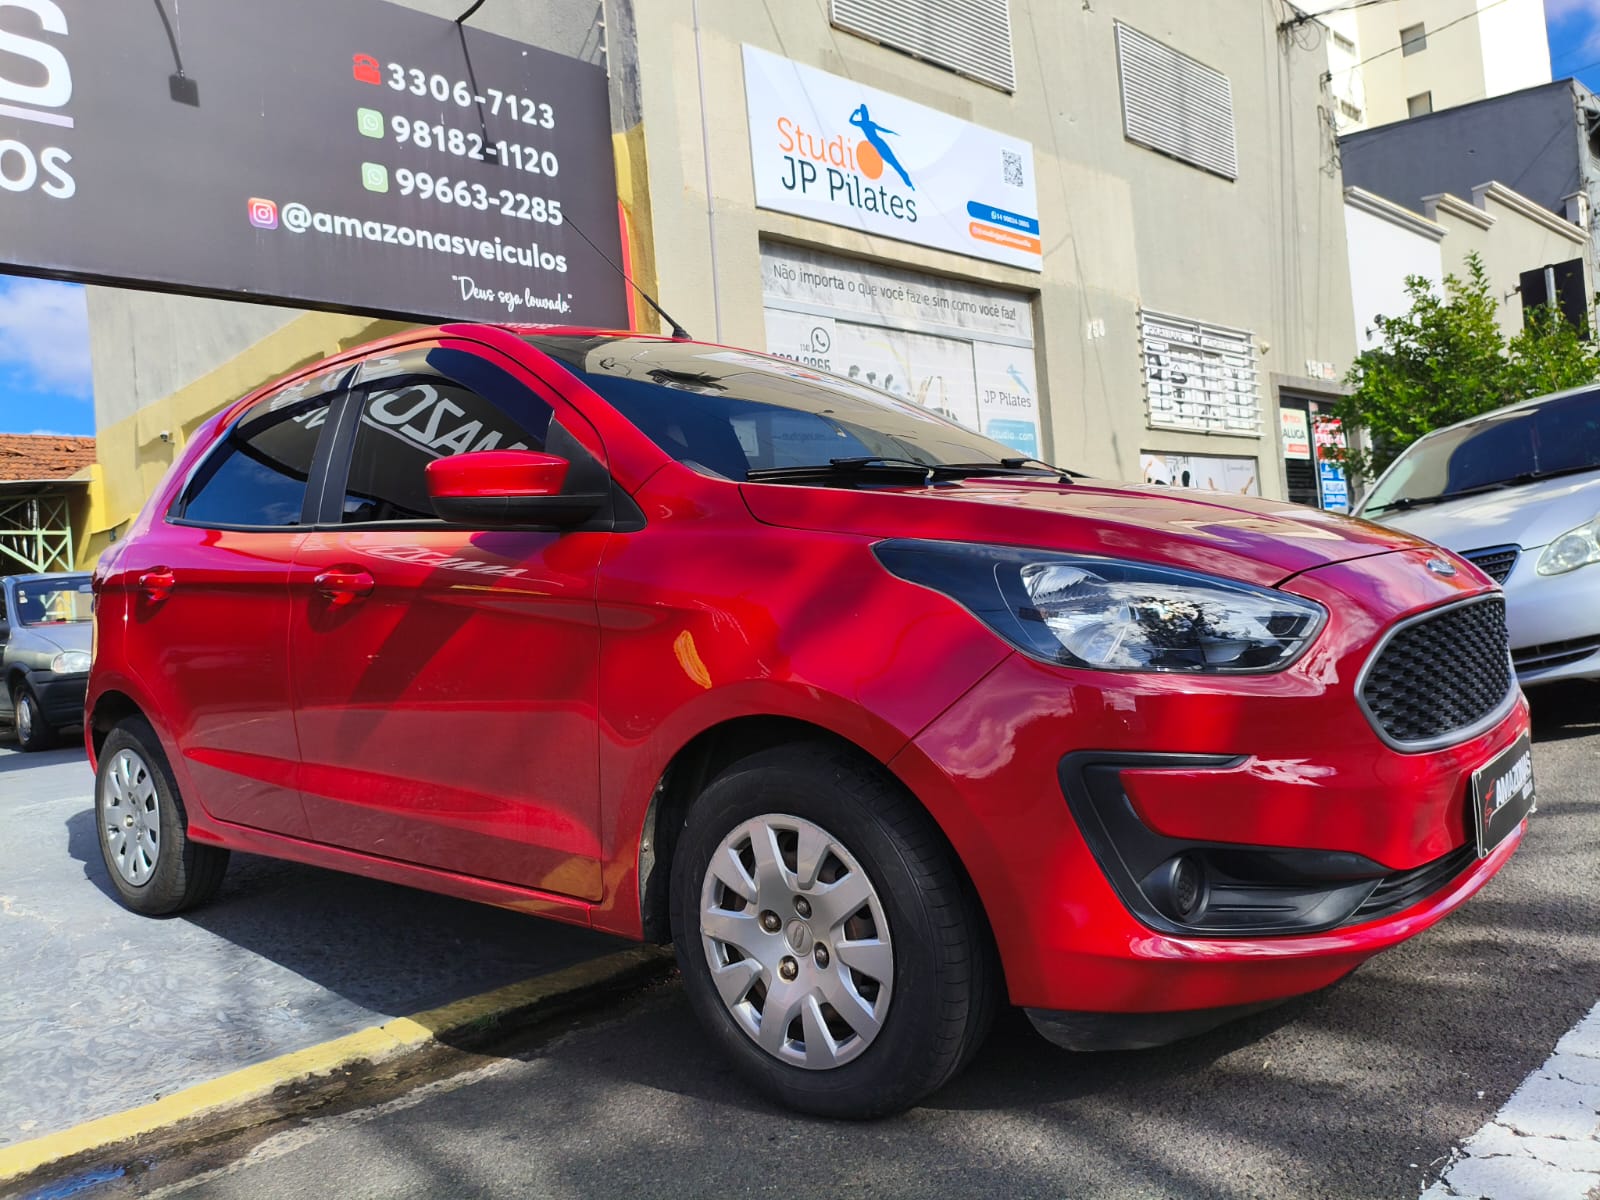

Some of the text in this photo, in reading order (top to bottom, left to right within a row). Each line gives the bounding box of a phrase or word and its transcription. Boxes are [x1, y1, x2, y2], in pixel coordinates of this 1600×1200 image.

[387, 62, 555, 129] 3306-7123
[391, 115, 559, 177] 98182-1120
[395, 168, 563, 226] 99663-2285
[781, 155, 918, 222] JP Pilates
[281, 201, 568, 273] @amazonasveiculos
[773, 264, 796, 281] Não
[799, 268, 845, 289] importa
[847, 281, 855, 292] o
[858, 283, 878, 297] que
[906, 288, 922, 304] faz
[924, 295, 930, 306] e
[932, 295, 950, 309] sim
[951, 299, 977, 313] como
[984, 390, 1032, 408] JP Pilates
